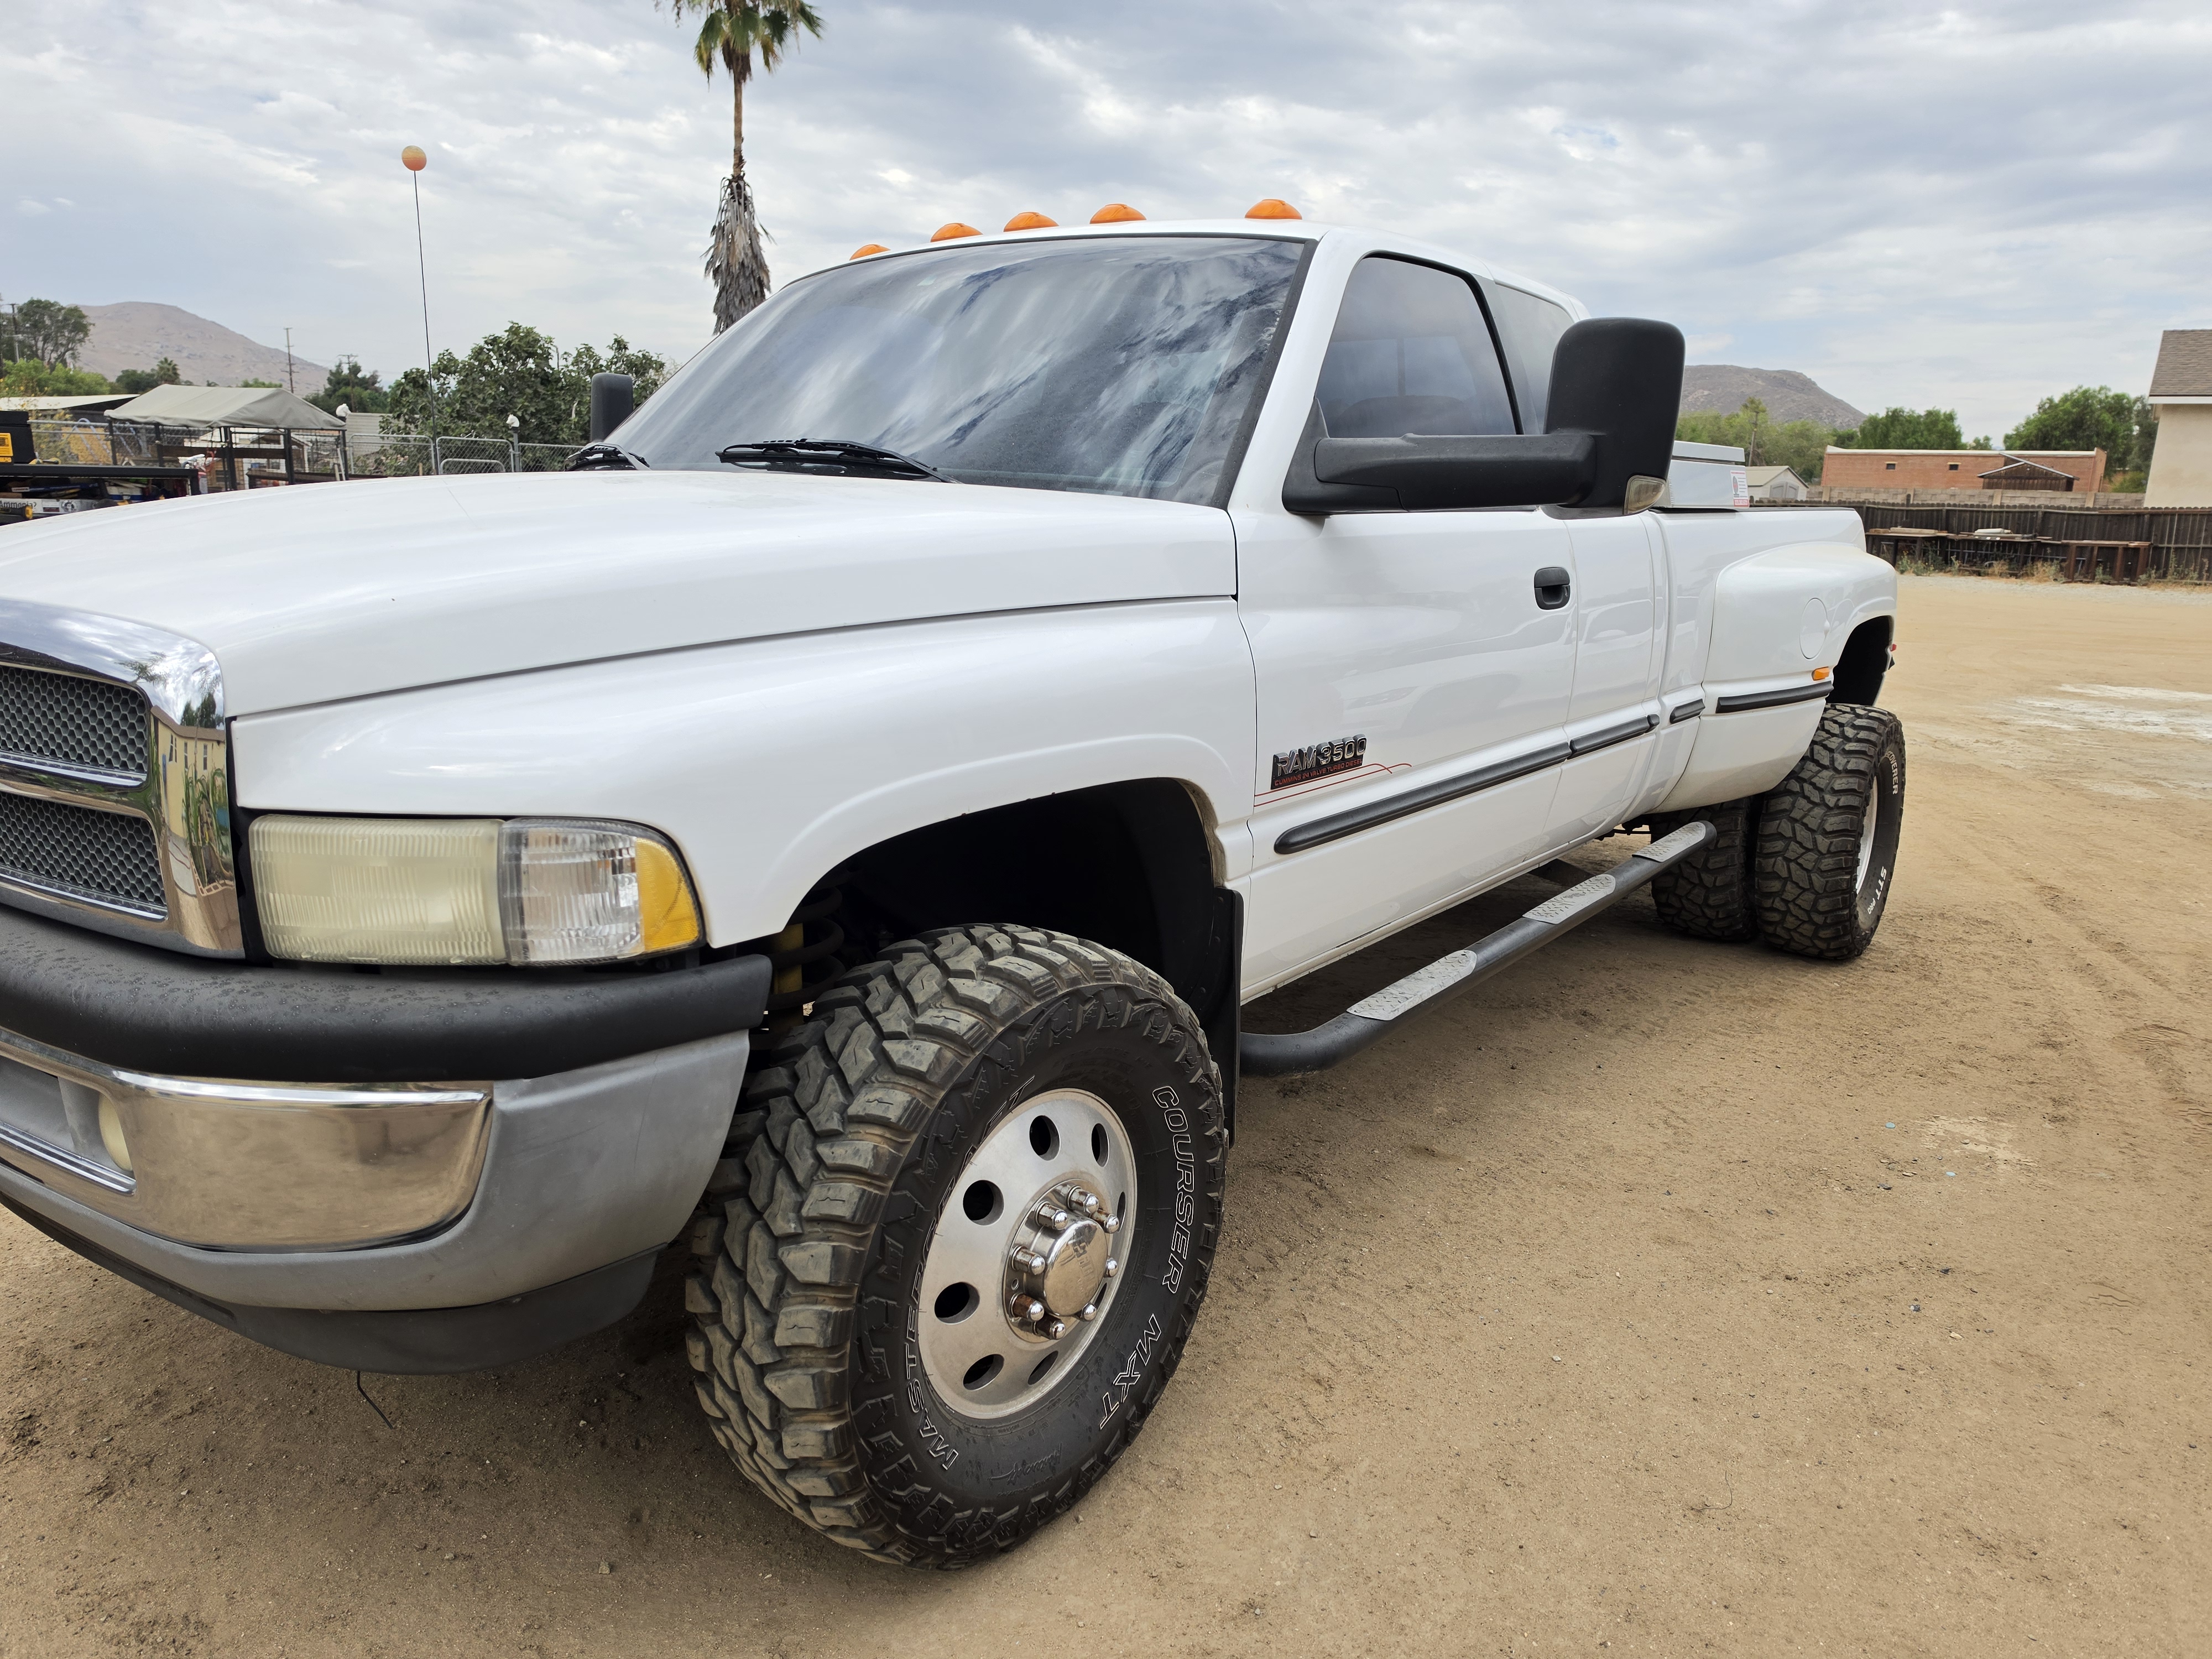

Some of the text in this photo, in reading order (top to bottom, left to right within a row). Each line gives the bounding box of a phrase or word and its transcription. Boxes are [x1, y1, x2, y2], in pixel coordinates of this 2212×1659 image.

[1274, 734, 1368, 776] RAM 3500
[1274, 774, 1302, 786] CUMMINS
[1310, 768, 1327, 779] VALVE
[1326, 763, 1346, 774] TURBO
[1345, 758, 1363, 768] DIESEL
[1867, 866, 1887, 915] STT PRO
[1152, 1085, 1195, 1295] COURSER
[1099, 1313, 1162, 1430] MXT
